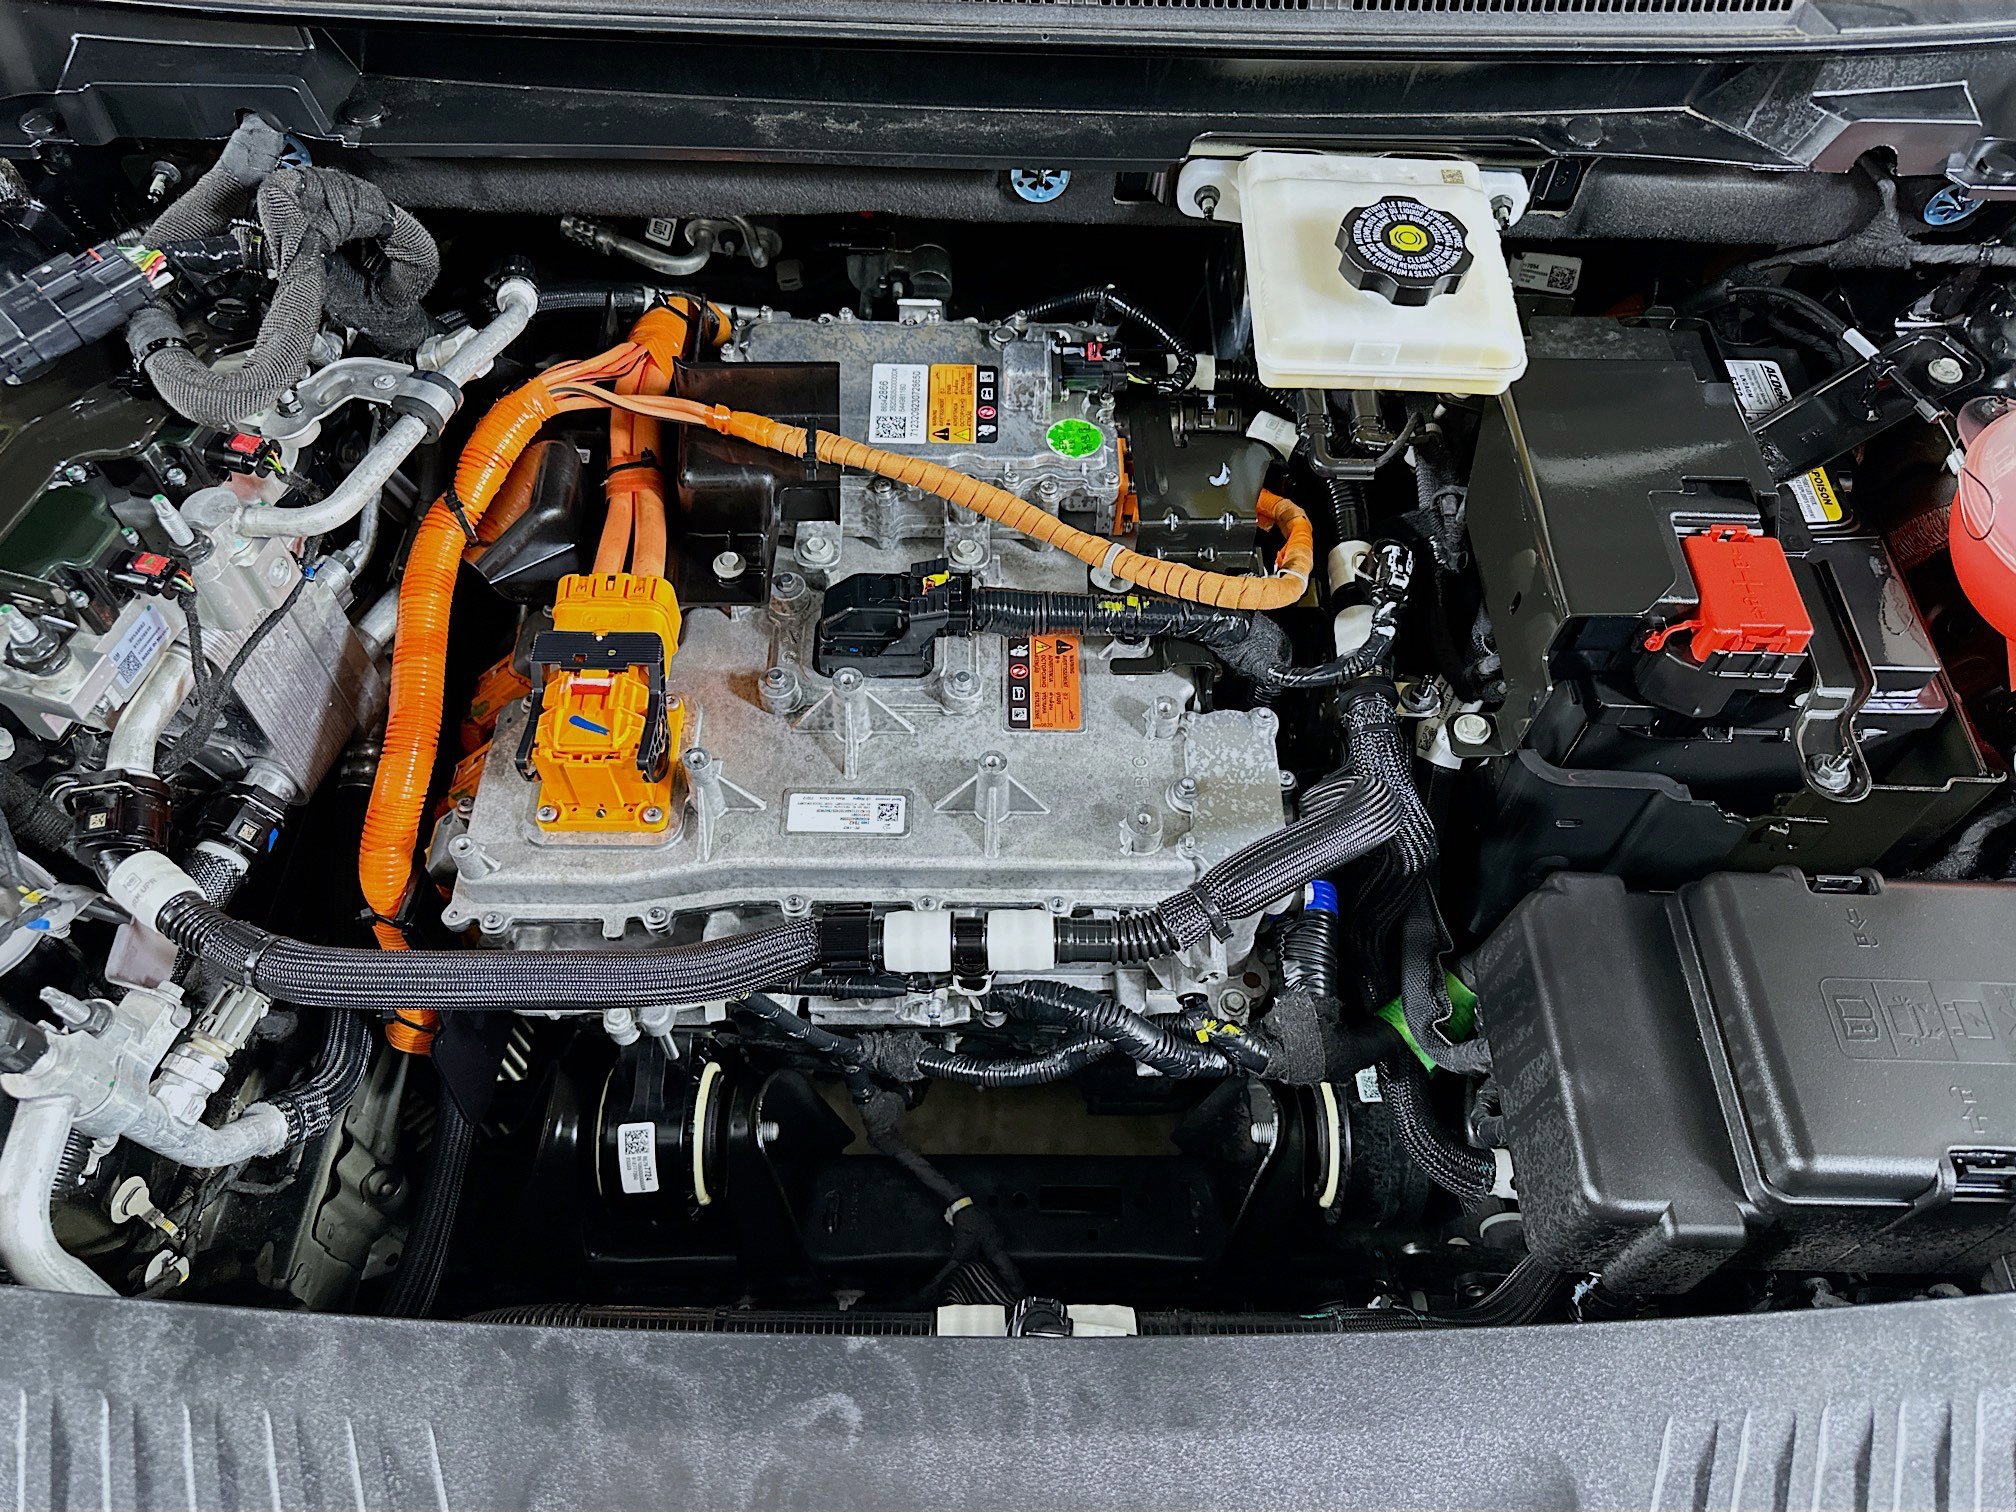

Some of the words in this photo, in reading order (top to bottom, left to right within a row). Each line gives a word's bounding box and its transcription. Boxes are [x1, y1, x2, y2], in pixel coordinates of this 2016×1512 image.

[1353, 219, 1364, 244] ATTENTION:
[1360, 203, 1387, 219] NETTOYER
[1397, 201, 1428, 212] BOUCHON
[1428, 210, 1449, 222] AVANT
[1446, 222, 1455, 230] LA
[1376, 210, 1388, 219] QUE
[1400, 208, 1424, 217] LIQUIDE
[1433, 220, 1449, 233] FREIN
[1409, 215, 1429, 226] BIDON
[1366, 243, 1378, 252] CAP
[1375, 252, 1399, 266] BEFORE
[1433, 257, 1446, 265] USE
[1441, 247, 1453, 259] ONLY
[1407, 255, 1429, 263] CLEAN
[1426, 245, 1443, 260] FILLER
[1369, 256, 1388, 270] FLUID
[1388, 266, 1407, 276] FROM
[1414, 268, 1439, 278] SEALED
[1765, 365, 1788, 405] ACDelc
[910, 371, 920, 436] 7123209230728650
[1811, 471, 1833, 505] POISON
[141, 646, 153, 661] MADE
[140, 878, 157, 893] UPR
